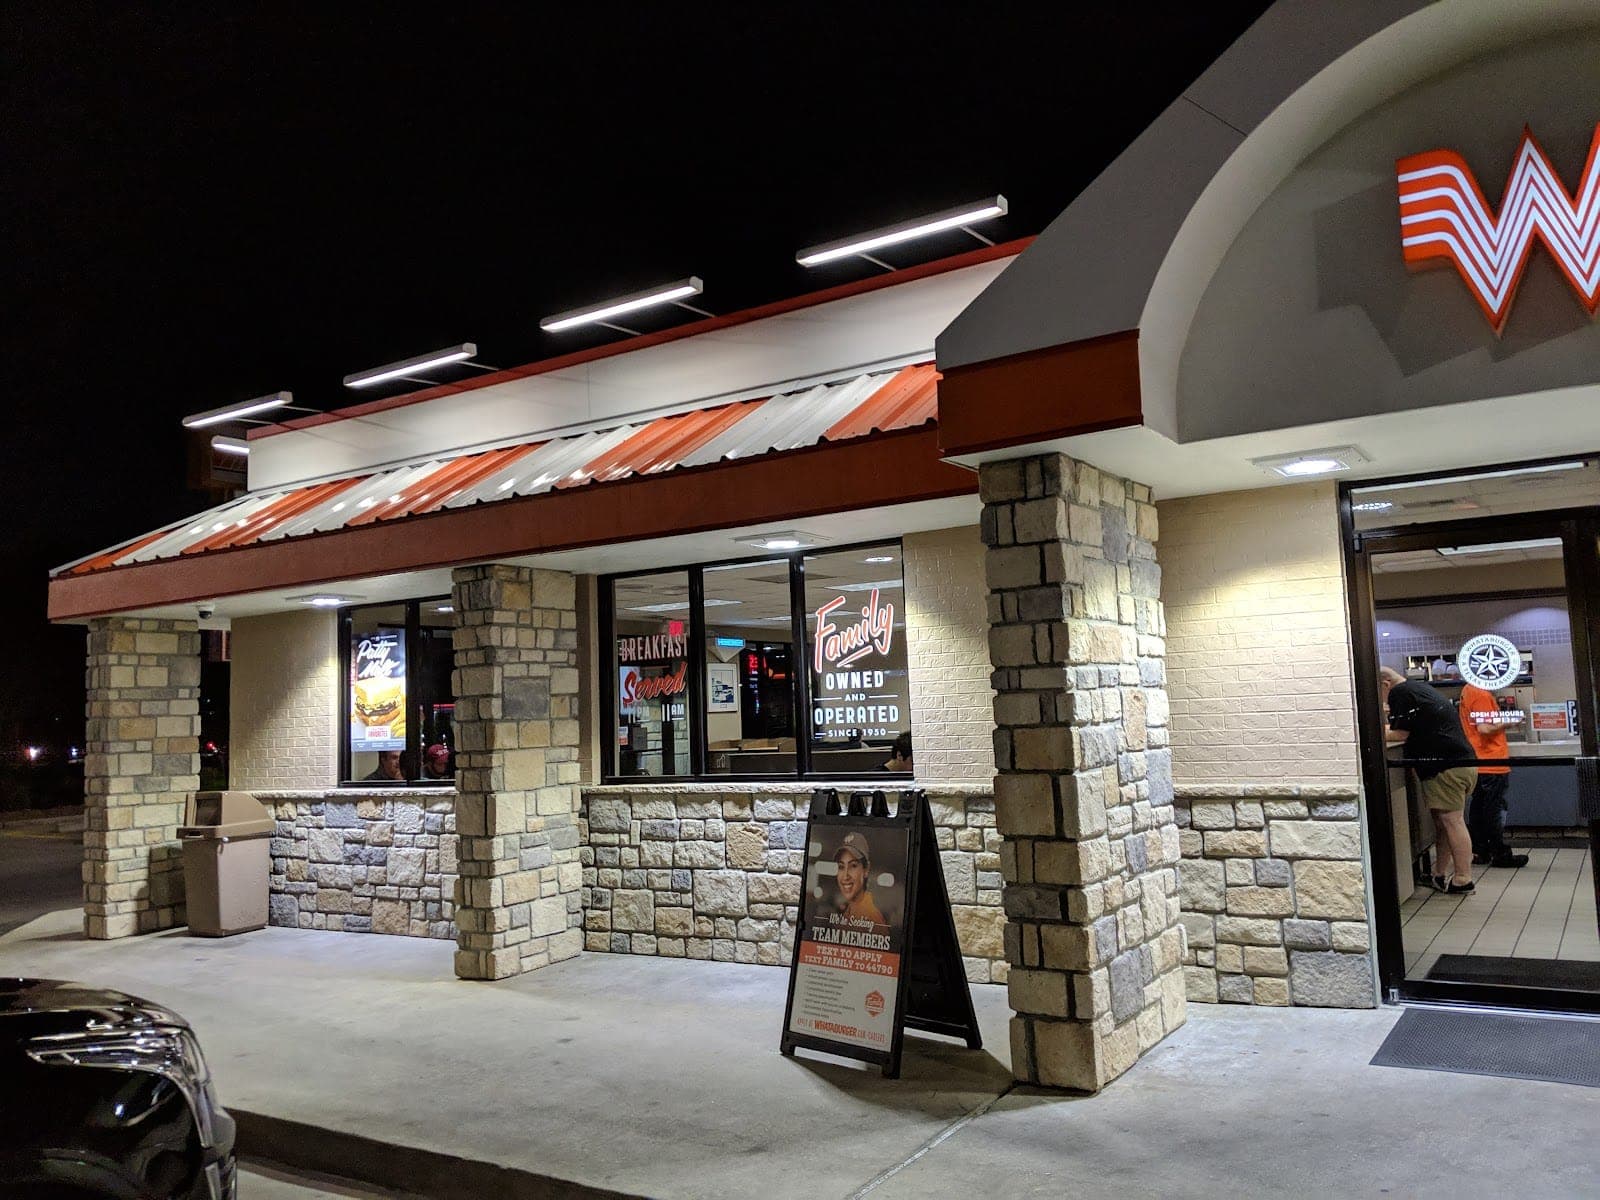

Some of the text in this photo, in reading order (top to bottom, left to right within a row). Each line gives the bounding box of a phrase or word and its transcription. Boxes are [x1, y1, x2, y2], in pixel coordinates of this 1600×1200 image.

[814, 588, 894, 673] Family
[621, 632, 688, 661] BREAKFAST
[622, 661, 688, 706] Served
[825, 670, 884, 690] OWNED
[844, 692, 866, 702] AND
[814, 705, 899, 726] OPERATED
[828, 727, 887, 738] SINCE 1950
[848, 915, 875, 932] Seeking
[811, 926, 891, 951] TEAM MEMBERS
[804, 955, 822, 963] TEXT
[822, 956, 854, 968] FAMILY
[816, 945, 883, 963] TEXT TO APPLY
